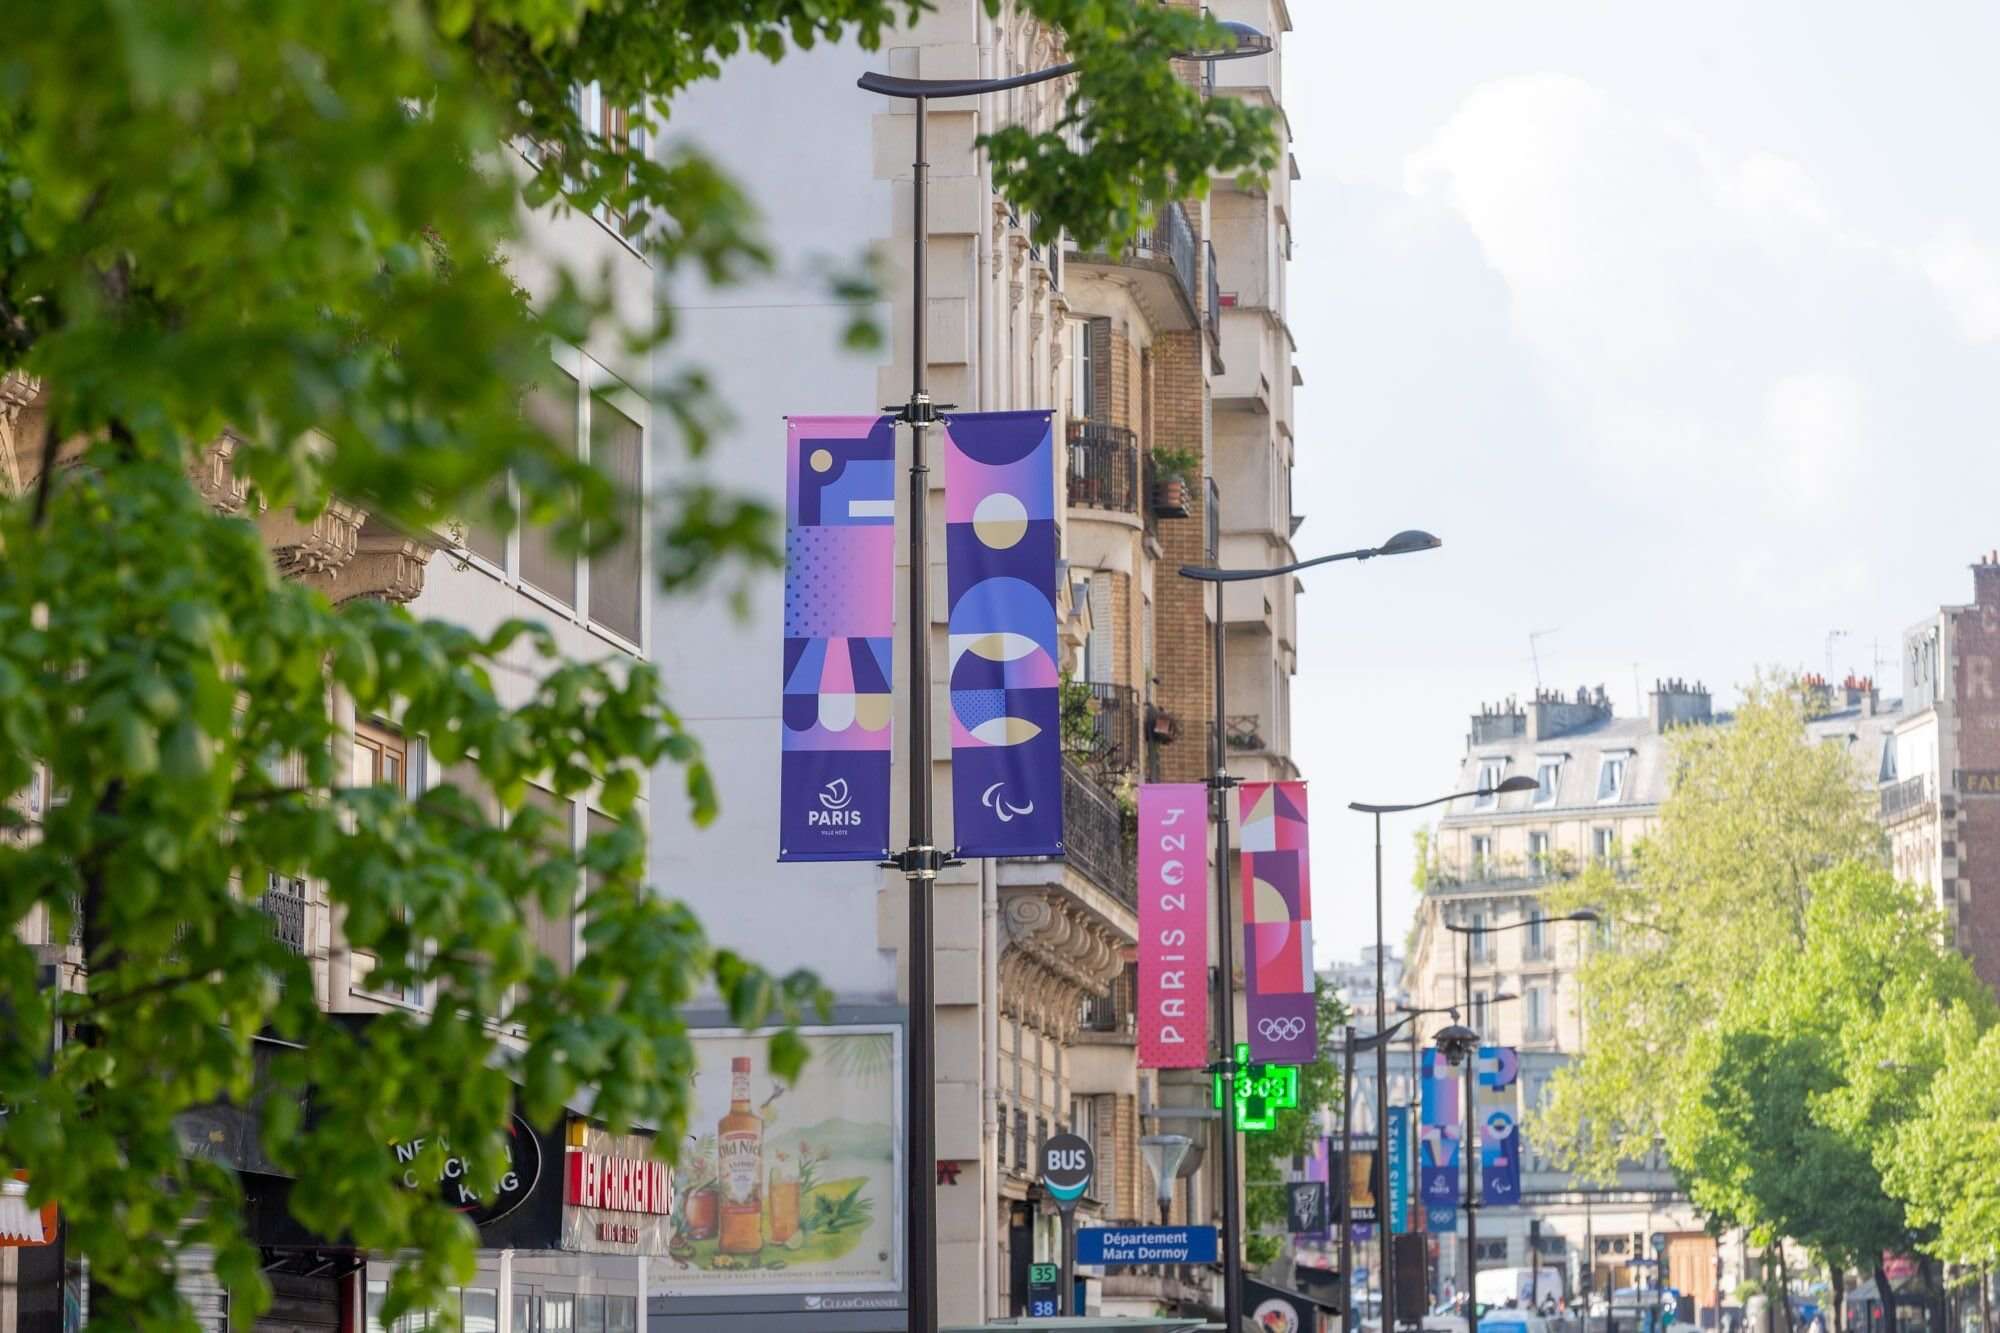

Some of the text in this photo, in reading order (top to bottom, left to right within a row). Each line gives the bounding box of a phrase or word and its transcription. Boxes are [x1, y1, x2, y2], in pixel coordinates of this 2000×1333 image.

[808, 811, 862, 826] PARIS
[1047, 1150, 1086, 1170] BUS
[580, 1152, 675, 1216] NEW CHICKEN KING
[1103, 1232, 1187, 1247] Département
[1103, 1248, 1188, 1261] Marx Dormoy
[1035, 1267, 1053, 1280] 35
[1035, 1301, 1053, 1316] 38
